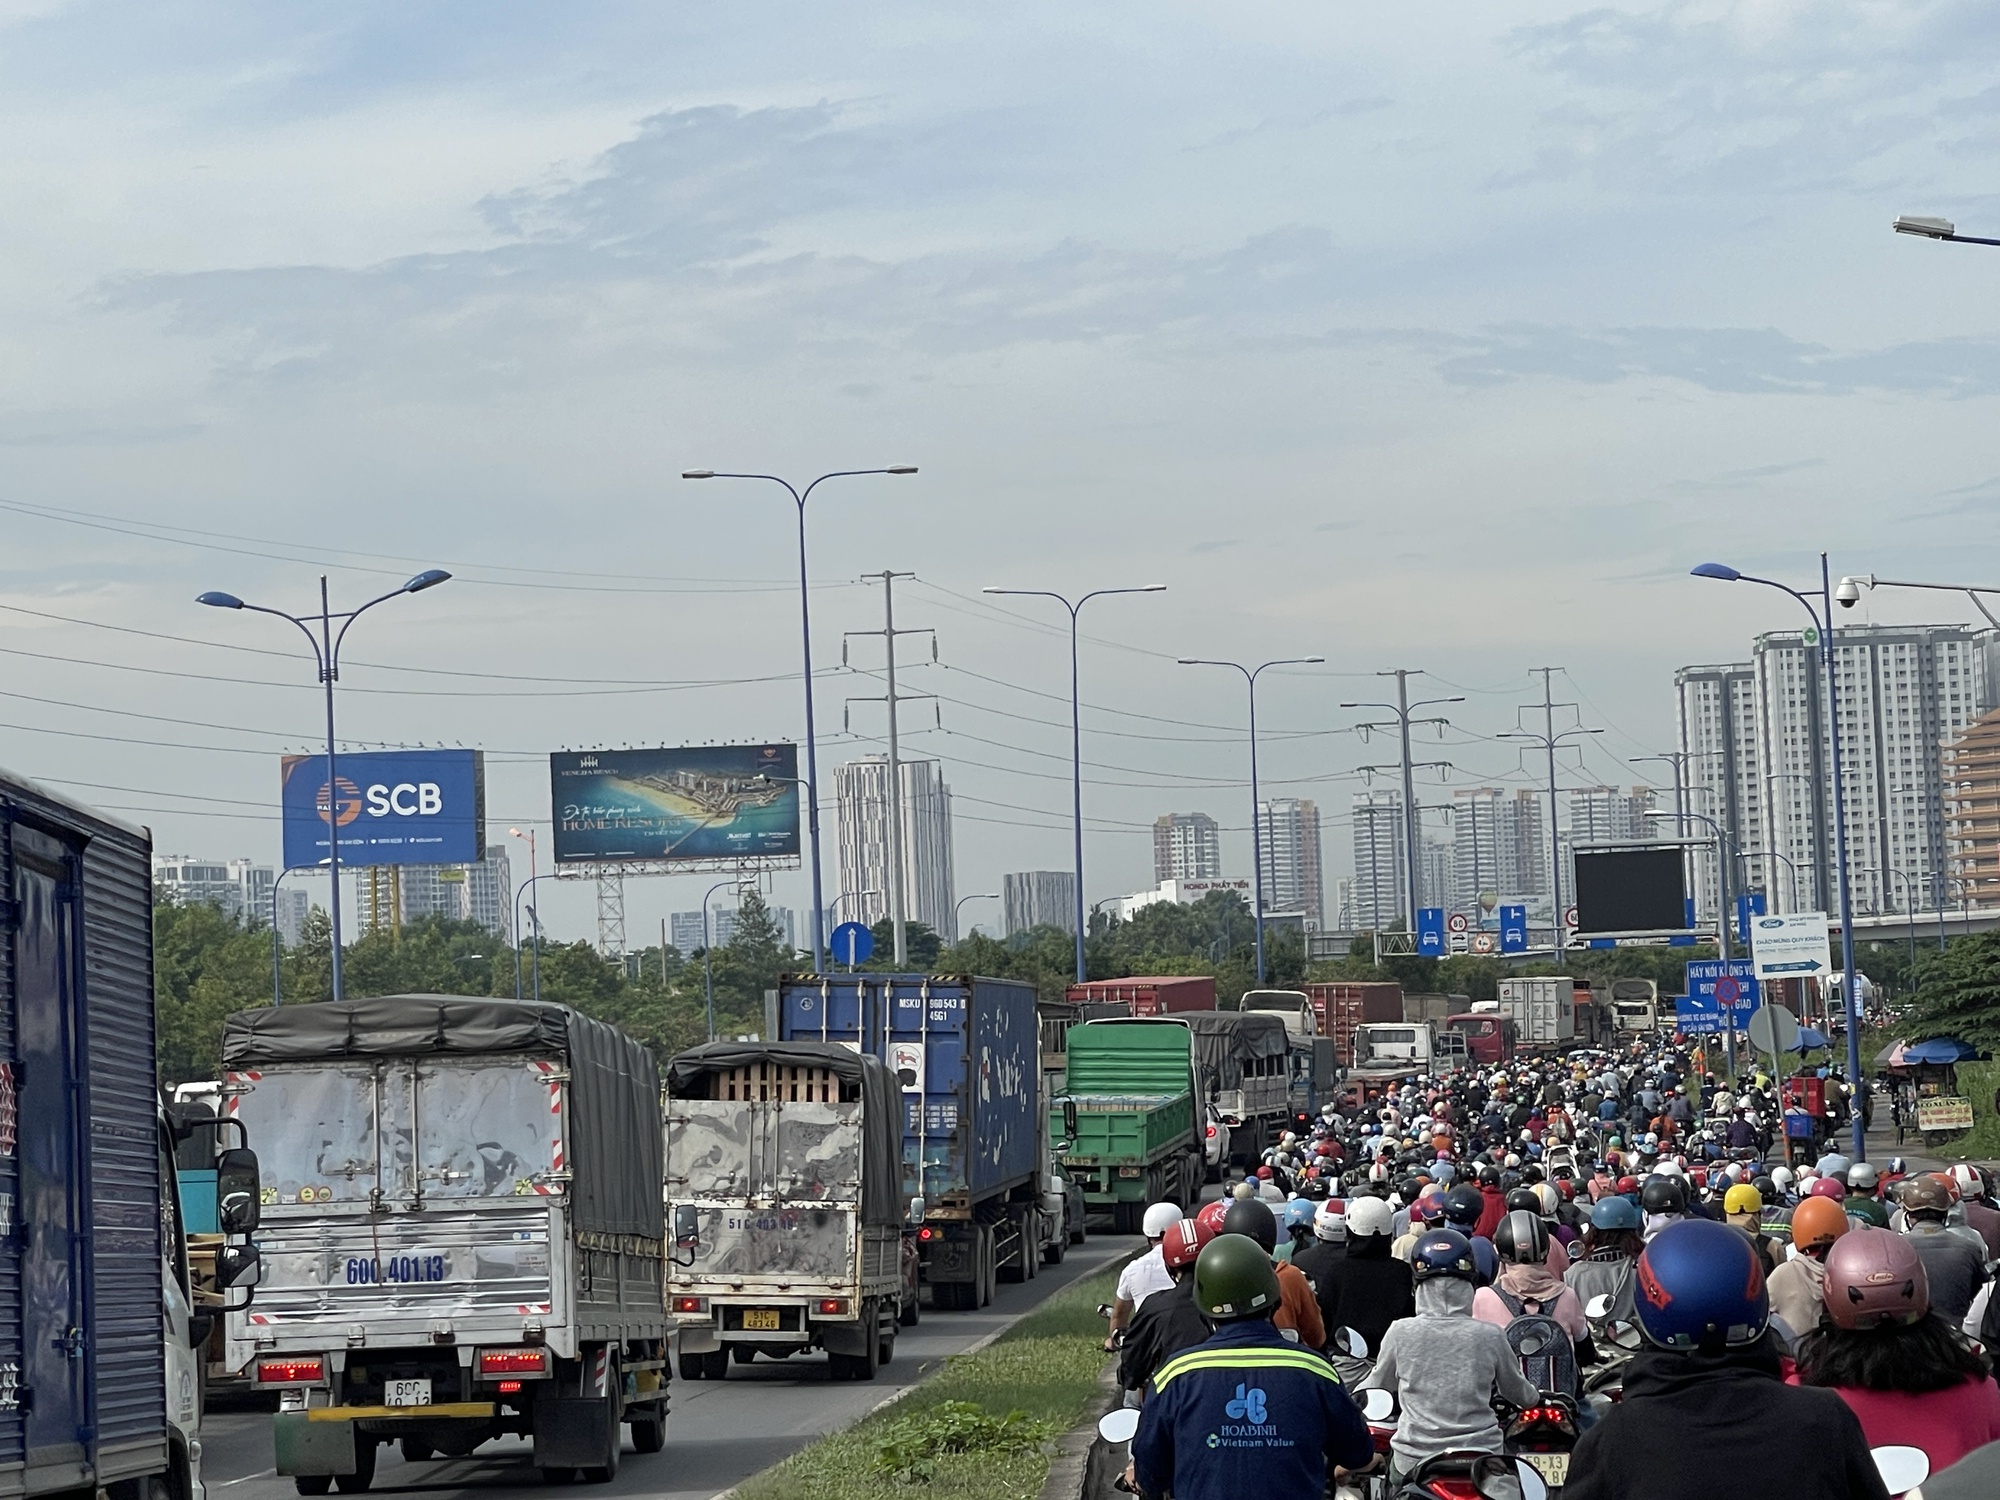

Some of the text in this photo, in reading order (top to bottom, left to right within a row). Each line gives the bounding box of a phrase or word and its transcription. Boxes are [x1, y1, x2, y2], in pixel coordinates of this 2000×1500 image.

[367, 783, 442, 817] SCB
[563, 818, 612, 831] HOME
[1211, 880, 1231, 889] PHÁT
[1453, 920, 1463, 928] 80
[1690, 964, 1704, 978] HÃY
[1705, 964, 1718, 978] NÓI
[1719, 964, 1743, 977] KÔNG
[899, 999, 920, 1008] MSKU
[1735, 999, 1752, 1009] GIAO
[929, 1011, 946, 1020] 45G1
[729, 1218, 750, 1229] 51C
[1221, 1438, 1295, 1447] Vietnam Value
